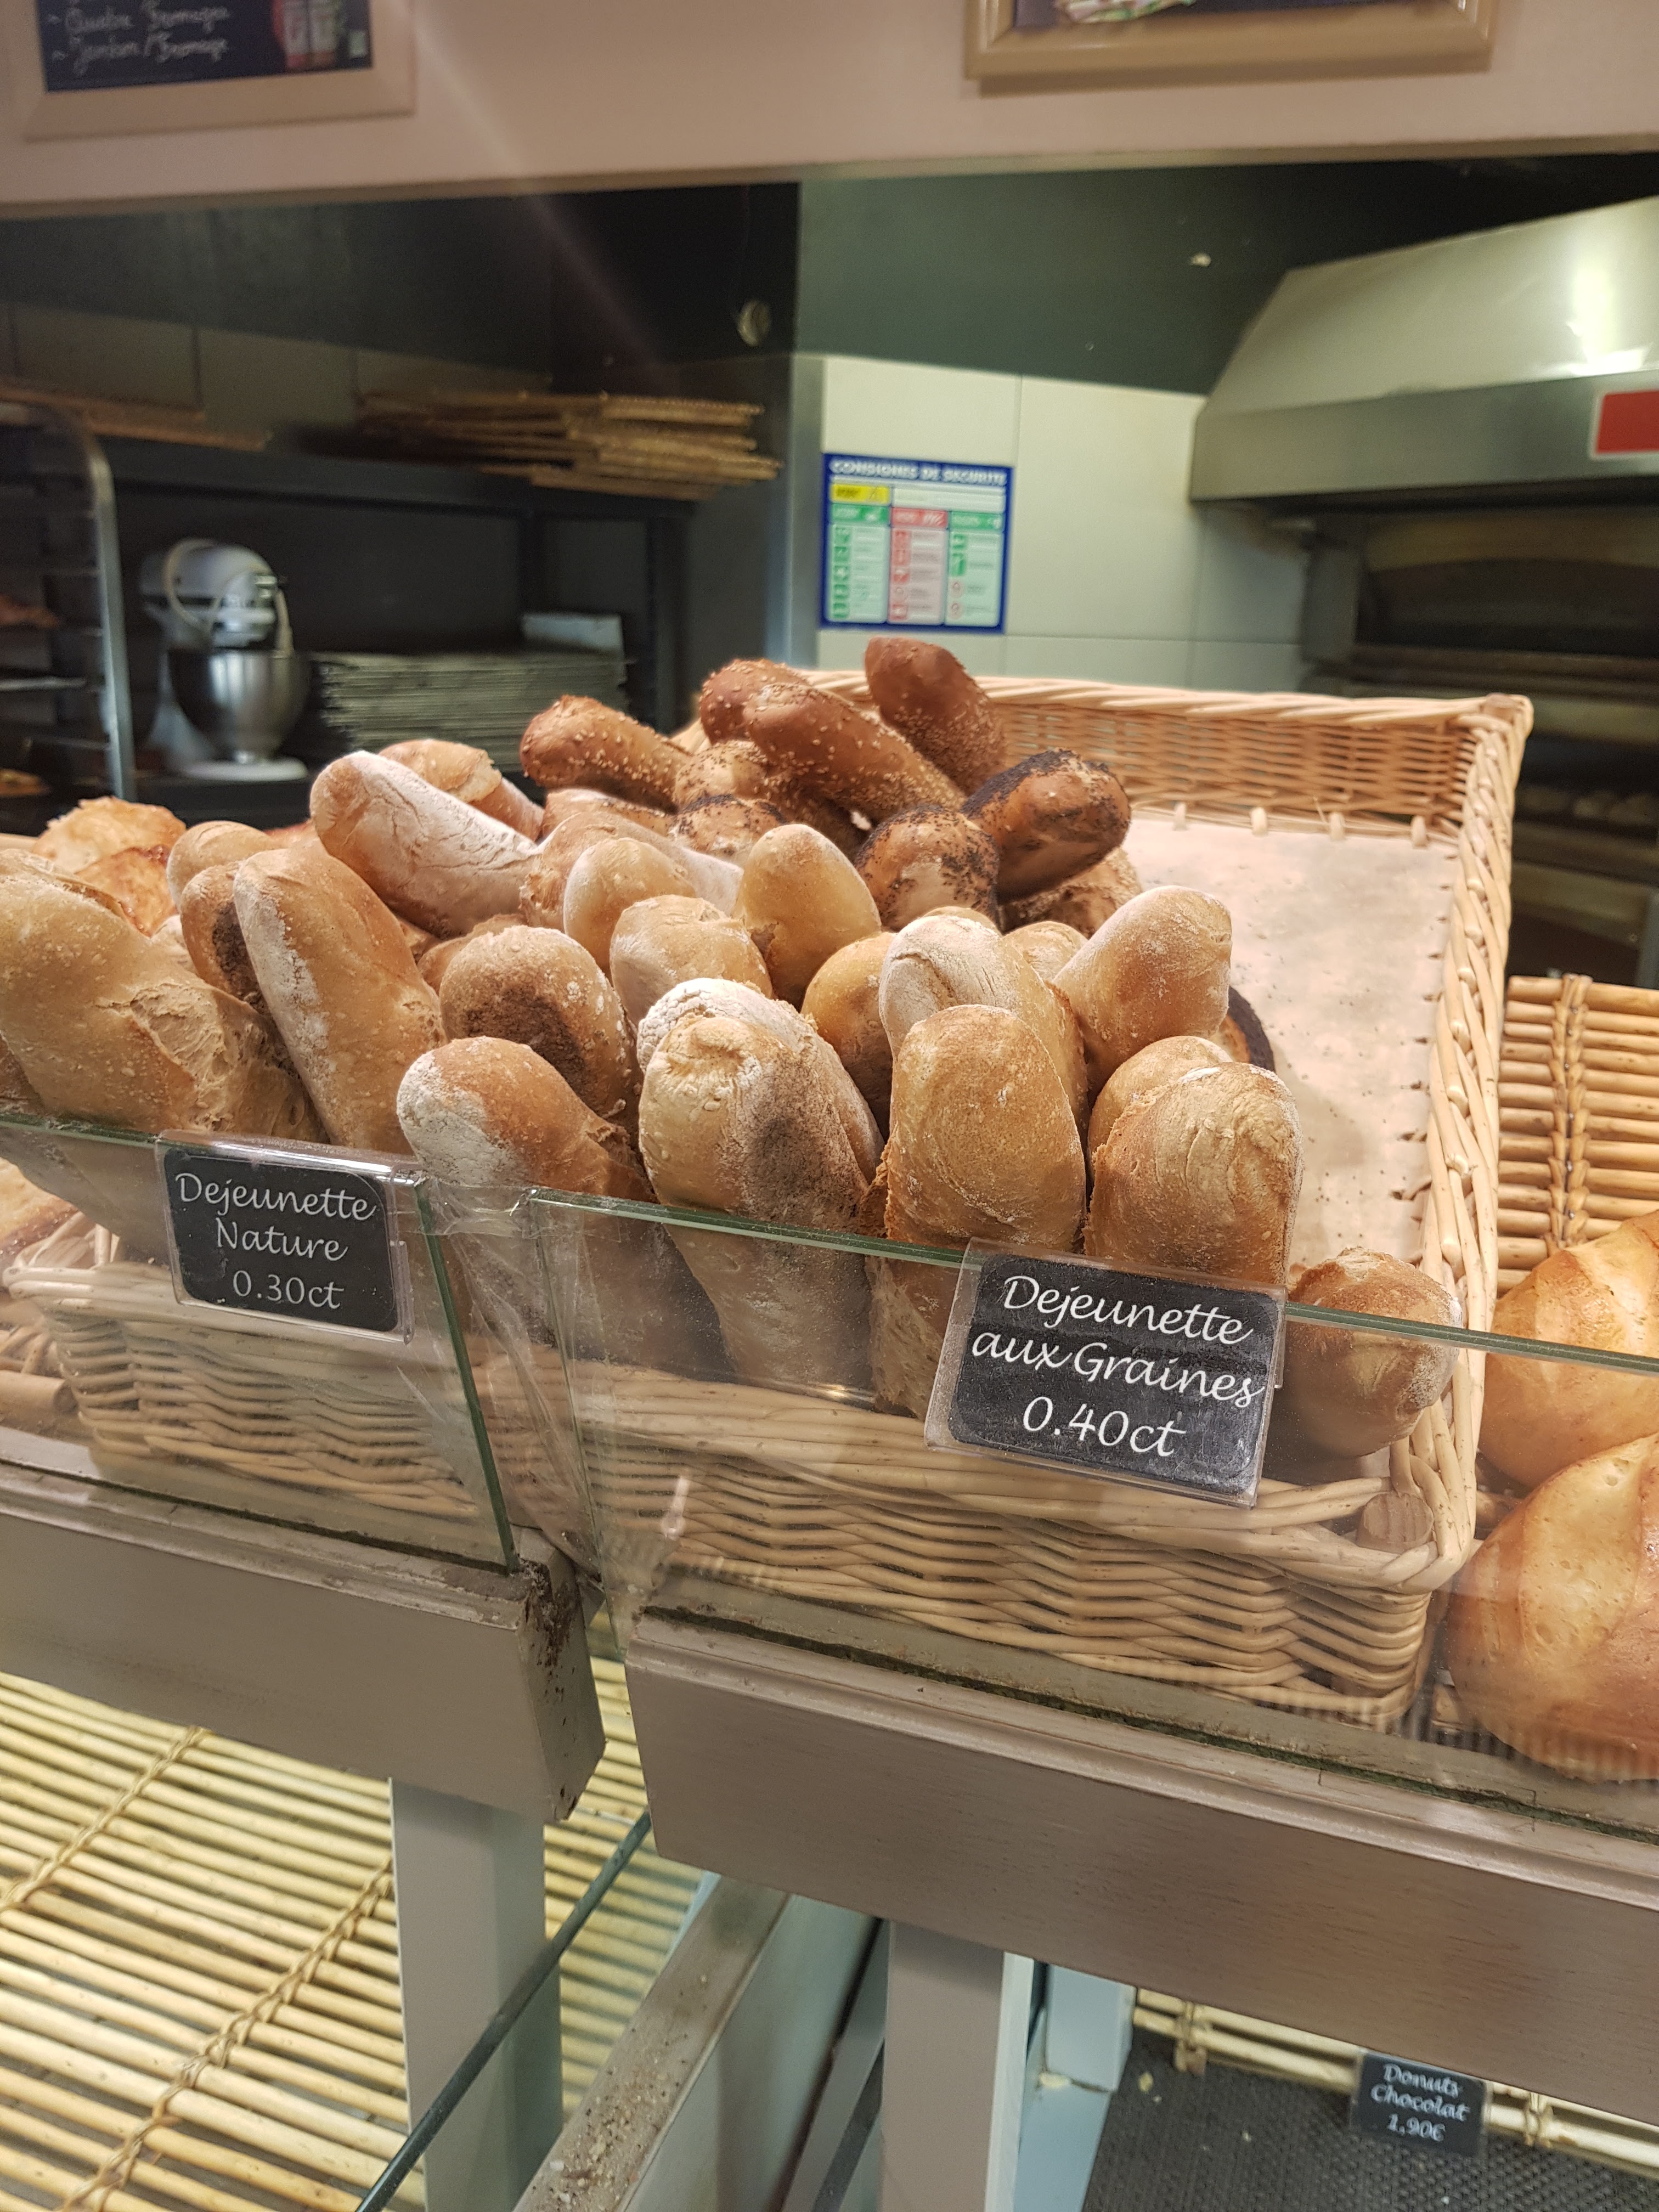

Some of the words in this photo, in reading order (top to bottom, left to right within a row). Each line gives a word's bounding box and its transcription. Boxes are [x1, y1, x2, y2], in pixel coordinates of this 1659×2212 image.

[174, 1172, 377, 1221] Dejeunette
[216, 1217, 348, 1261] Nature
[232, 1270, 345, 1310] 0.30ct
[1003, 1276, 1254, 1345] Dejeunette
[972, 1332, 1073, 1370] aux
[1074, 1342, 1265, 1408] Graines
[1023, 1397, 1187, 1457] 0.40ct
[1384, 2063, 1463, 2097] Donuts
[1371, 2085, 1471, 2122] Chocolat
